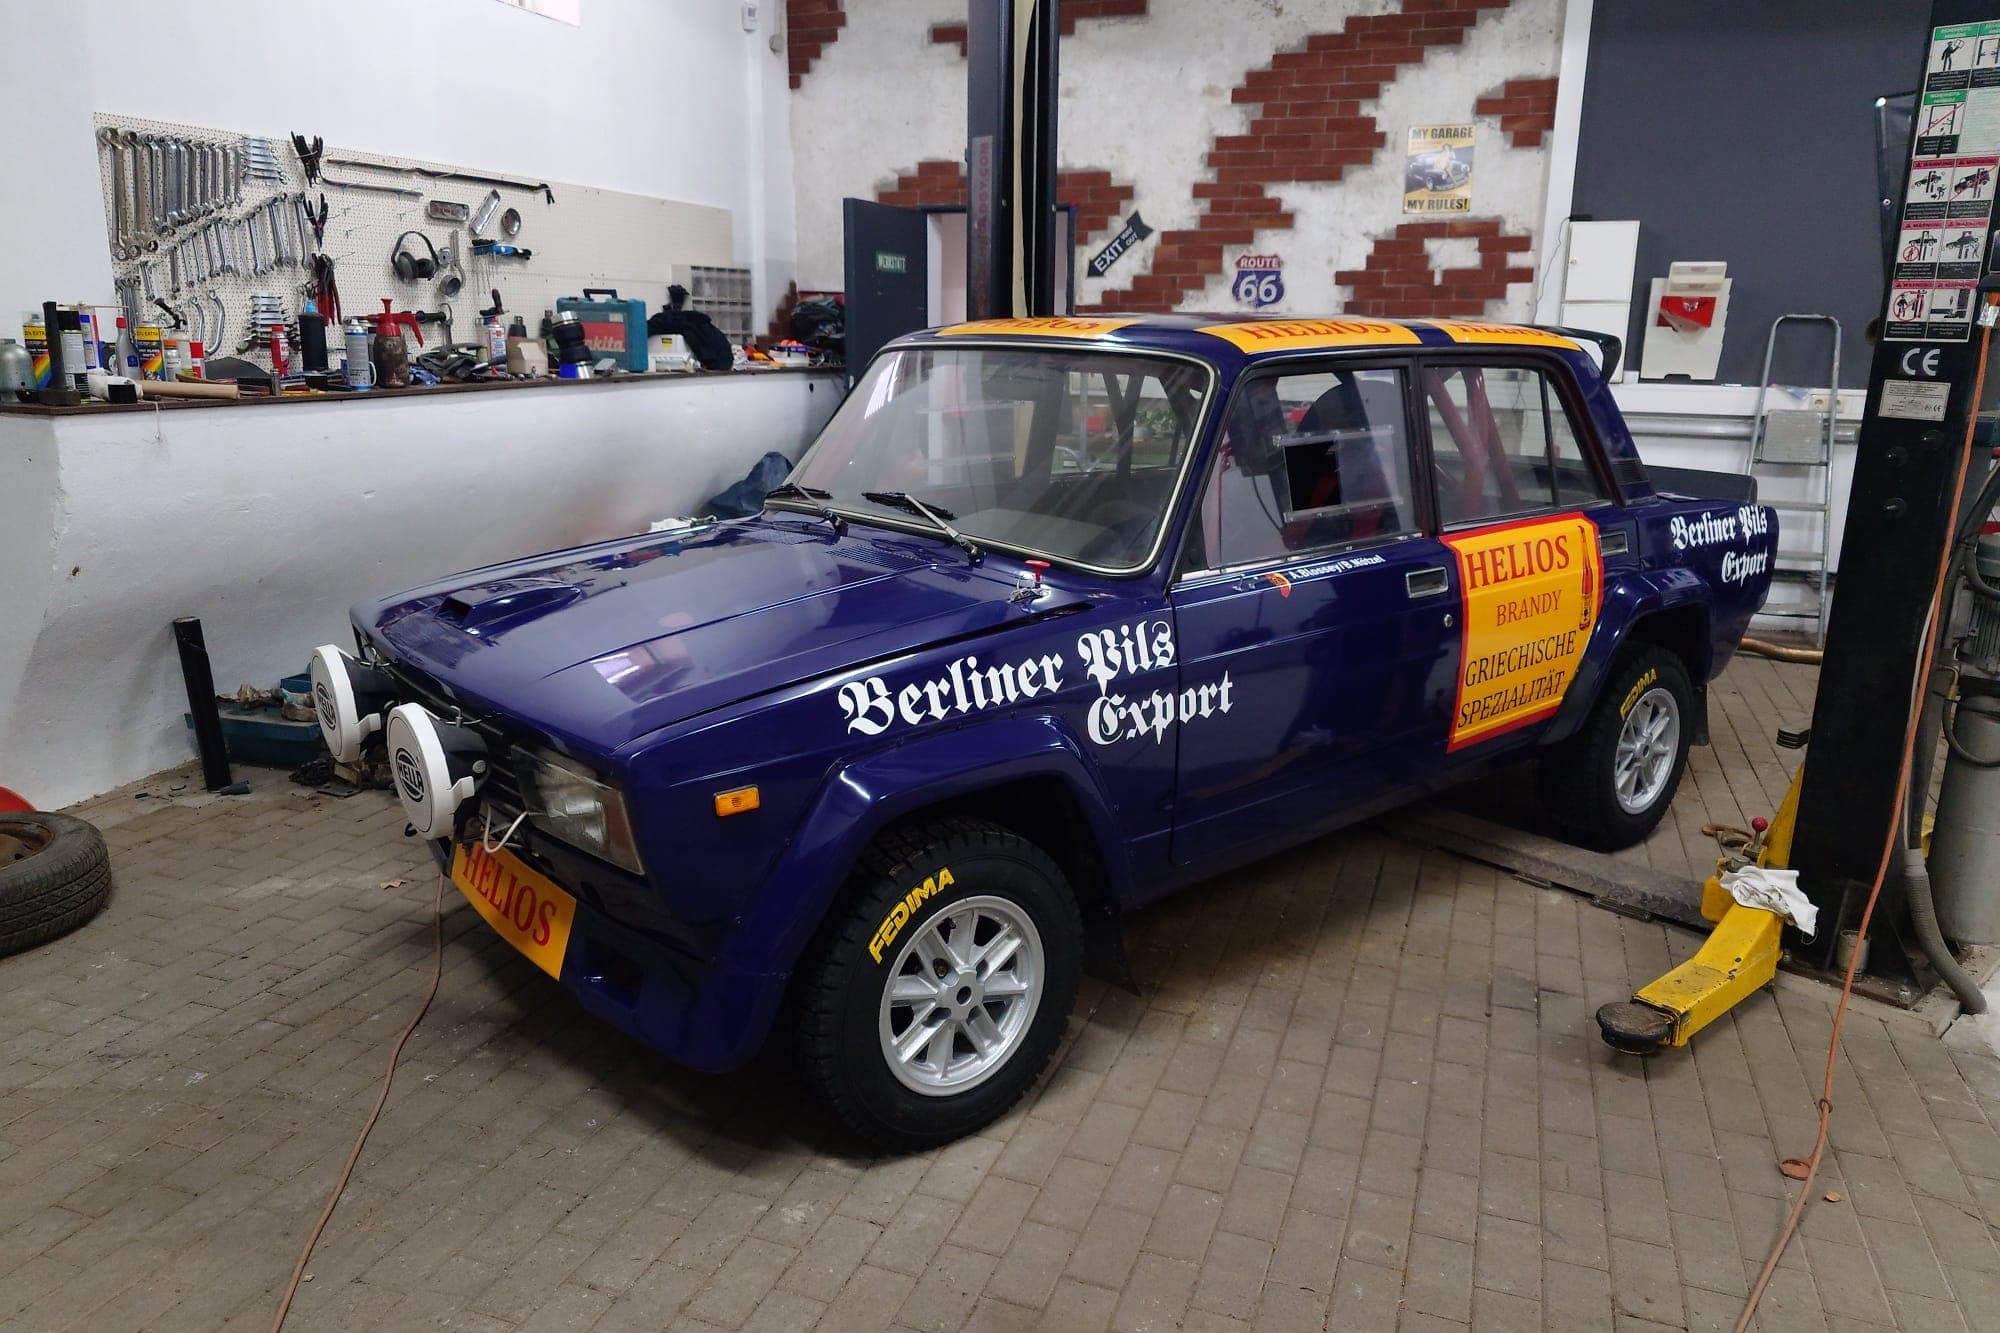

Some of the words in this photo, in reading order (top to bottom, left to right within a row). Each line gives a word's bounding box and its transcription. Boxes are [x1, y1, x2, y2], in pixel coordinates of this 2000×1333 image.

[1412, 128, 1428, 139] MY
[1431, 127, 1473, 139] GARAGE
[1407, 199, 1425, 209] MY
[1427, 198, 1469, 210] RULES!
[1094, 239, 1123, 272] EXIT
[1125, 232, 1138, 246] OUT
[1240, 257, 1279, 268] ROUTE
[1239, 274, 1278, 303] 66
[1239, 322, 1392, 340] HELIOS
[1671, 512, 1736, 550] Berliner
[1738, 504, 1768, 546] Pils
[1465, 535, 1570, 590] HELIOS
[1721, 544, 1768, 588] Export
[1496, 589, 1563, 627] BRANDY
[838, 652, 1064, 736] Berliner
[1077, 620, 1175, 697] Pils
[1465, 629, 1577, 687] GRIECHISCHE
[1087, 670, 1233, 745] Export
[1457, 668, 1566, 729] SPEZIALITÄT
[1619, 668, 1657, 721] FEDIMA
[397, 760, 423, 794] HELLA
[462, 845, 558, 947] HELIOS
[868, 867, 955, 965] FEDIMA
